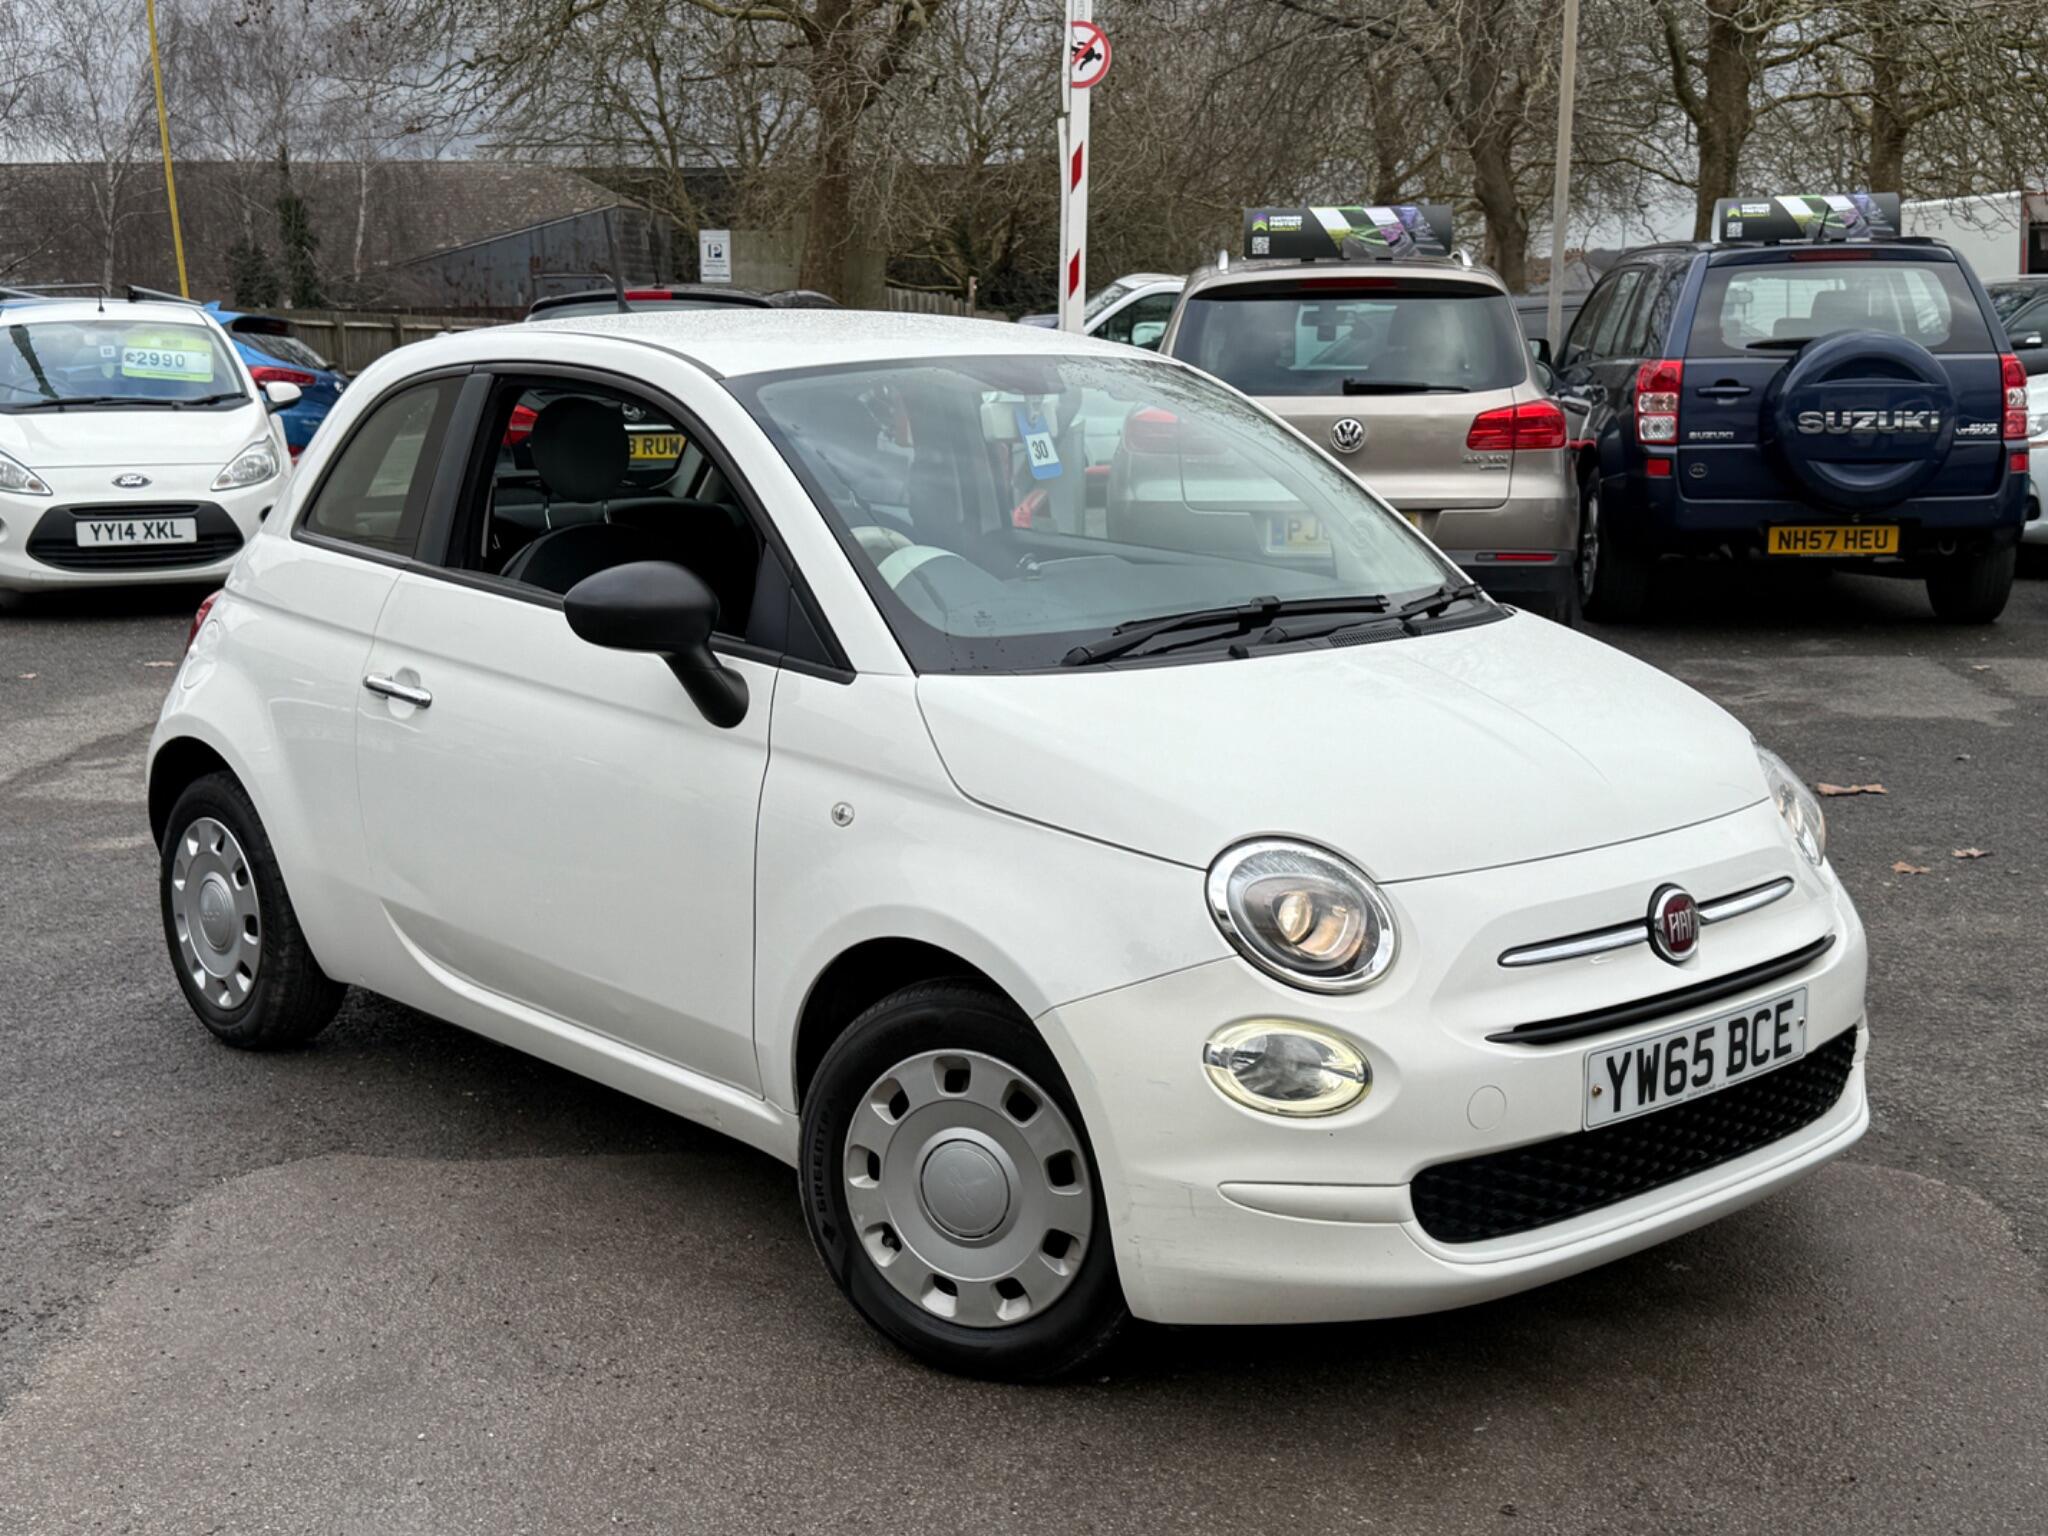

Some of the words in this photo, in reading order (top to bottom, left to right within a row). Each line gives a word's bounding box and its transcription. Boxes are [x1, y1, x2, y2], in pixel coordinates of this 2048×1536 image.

[125, 352, 186, 368] £2990
[1797, 410, 1940, 435] SUZUKI
[1688, 431, 1735, 440] SUZUKI
[642, 438, 680, 455] RUW
[1032, 440, 1049, 460] 30
[90, 523, 137, 541] YY14
[142, 521, 183, 539] XKL
[1778, 529, 1838, 550] NH57
[1844, 529, 1889, 549] HEU
[1667, 909, 1693, 944] FIAT
[1606, 1026, 1716, 1113] YW65
[1726, 999, 1794, 1077] BCE
